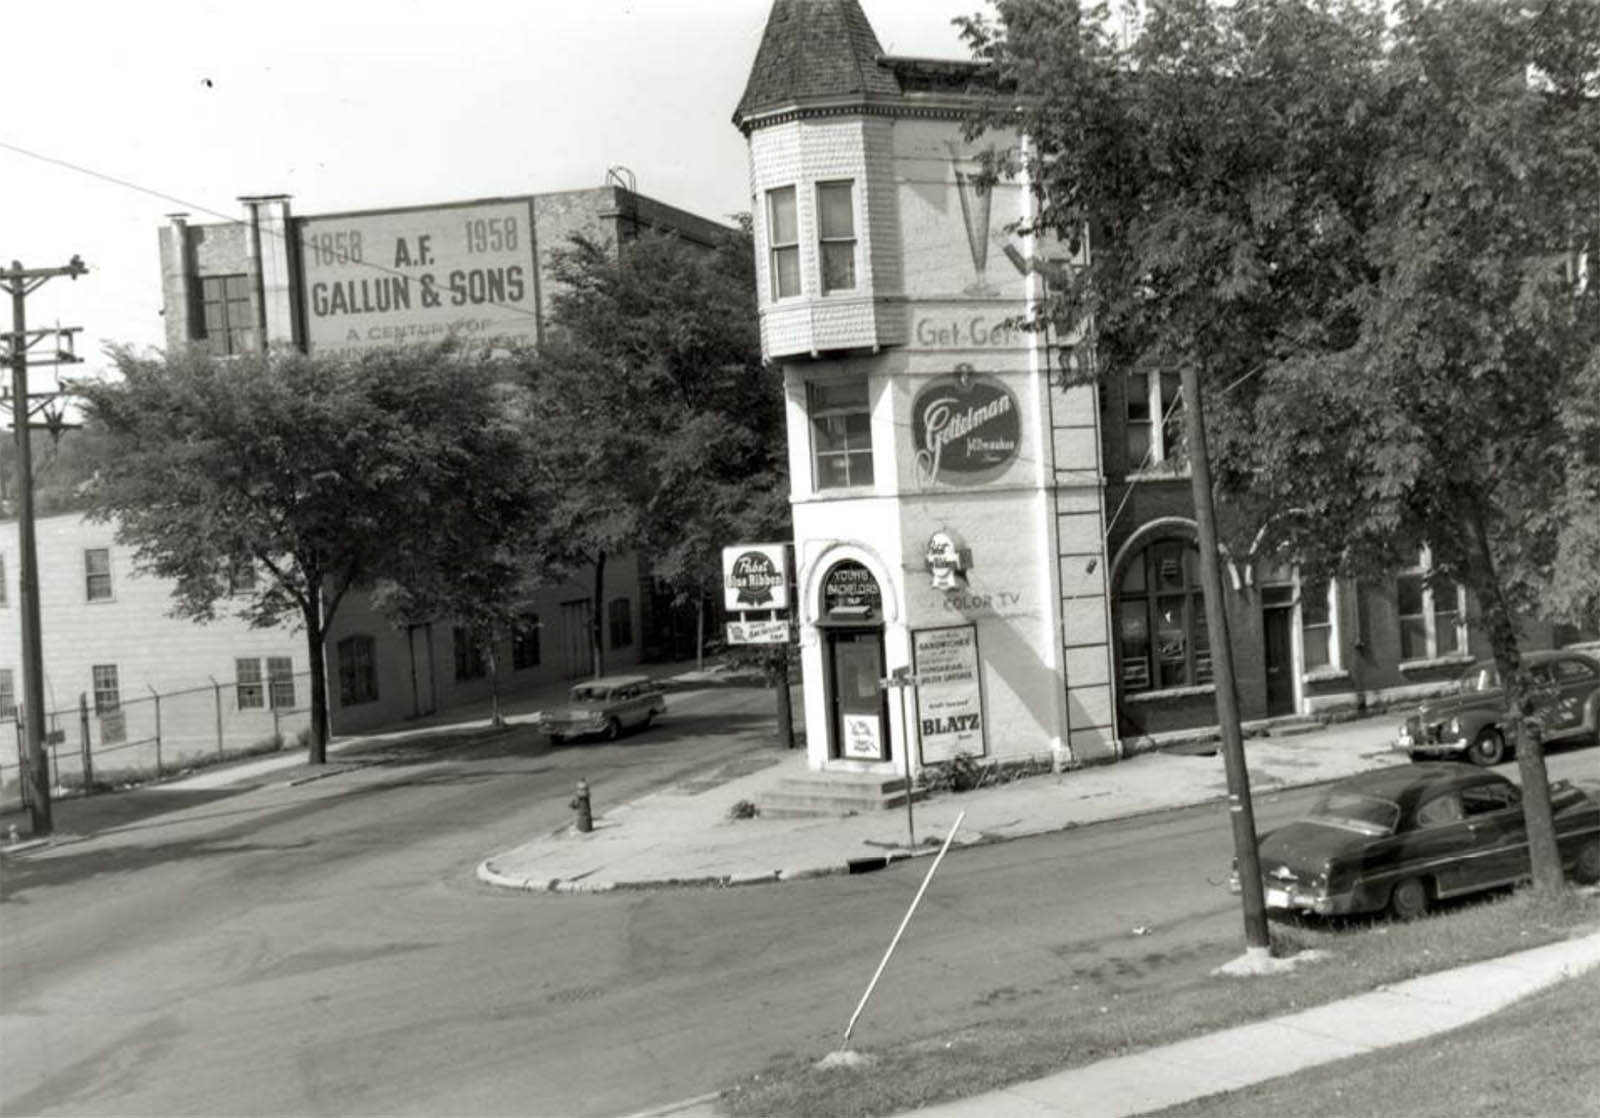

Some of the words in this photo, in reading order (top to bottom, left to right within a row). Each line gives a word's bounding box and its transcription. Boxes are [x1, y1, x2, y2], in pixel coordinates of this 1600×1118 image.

[311, 230, 363, 268] 1858
[395, 234, 435, 268] A.F.
[465, 216, 518, 253] 1958
[312, 277, 411, 317] GALLUN
[420, 273, 442, 308] &
[450, 265, 525, 306] SONS
[916, 318, 960, 346] Get
[943, 595, 993, 613] COLOR
[998, 592, 1021, 606] TV
[922, 713, 980, 737] BLATZ
